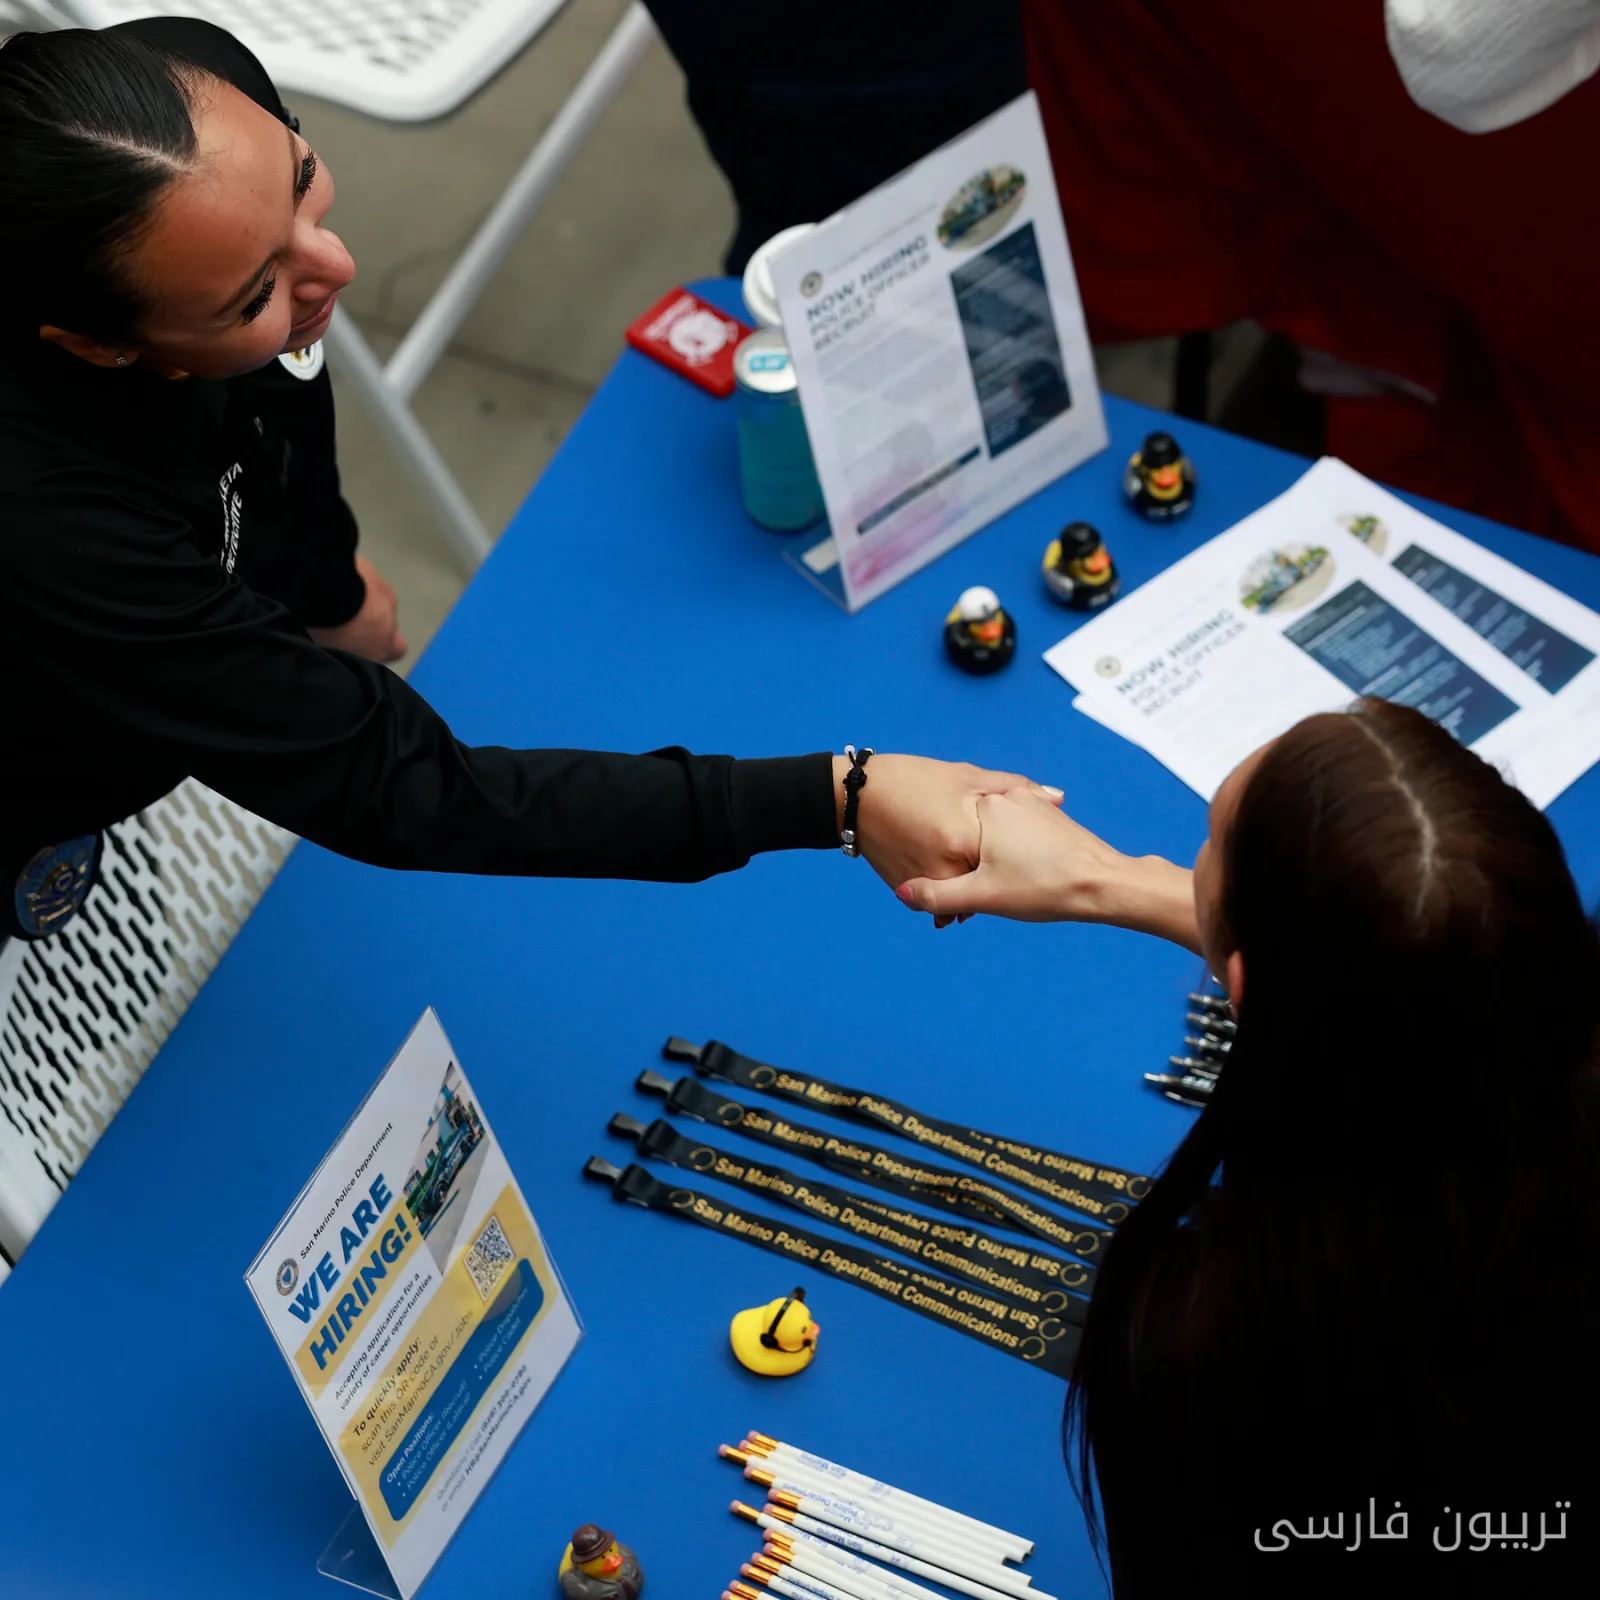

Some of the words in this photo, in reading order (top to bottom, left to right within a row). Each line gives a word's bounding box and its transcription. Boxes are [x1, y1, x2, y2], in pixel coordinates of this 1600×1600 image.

[806, 284, 854, 320] NOW
[860, 235, 925, 284] HIRING
[226, 491, 242, 574] DETECTIVE
[1116, 658, 1166, 695] NOW
[1167, 611, 1233, 659] HIRING
[300, 1239, 314, 1260] San
[312, 1207, 336, 1240] Marino
[334, 1177, 356, 1208] Police
[354, 1122, 393, 1179] Department
[743, 1112, 772, 1131] San
[773, 1122, 824, 1148] Marino
[825, 1139, 871, 1162] Police
[873, 1152, 957, 1202] Department
[958, 1178, 1073, 1242] Communications
[775, 1075, 806, 1093] San
[807, 1083, 856, 1105] Marino
[858, 1096, 903, 1124] Police
[903, 1116, 986, 1163] Department
[985, 1153, 1103, 1214] Communications
[1043, 1155, 1095, 1181] Marino
[1097, 1170, 1128, 1189] San
[288, 1252, 340, 1324] WE
[340, 1174, 392, 1263] ARE
[693, 1199, 723, 1223] San
[723, 1213, 773, 1240] Marino
[774, 1232, 819, 1259] Police
[820, 1249, 903, 1295] Department
[903, 1286, 1019, 1347] Communications
[715, 1158, 744, 1178] San
[744, 1168, 794, 1195] Marino
[794, 1187, 839, 1217] Police
[840, 1208, 923, 1253] Department
[923, 1243, 1041, 1302] Communications
[978, 1239, 1029, 1267] Marino
[1031, 1256, 1061, 1276] San
[310, 1214, 411, 1369] HIRING!
[957, 1290, 1008, 1319] Marino
[1009, 1309, 1040, 1329] San
[335, 1351, 368, 1399] Accepting
[366, 1295, 405, 1353] applications
[402, 1280, 414, 1296] for
[340, 1376, 363, 1411] variety
[362, 1364, 371, 1379] of
[370, 1335, 391, 1367] career
[390, 1274, 432, 1336] opportunities
[353, 1420, 367, 1437] To
[365, 1374, 396, 1422] quickly
[395, 1336, 422, 1377] apply:
[361, 1422, 381, 1451] scan
[380, 1402, 397, 1424] this
[396, 1378, 410, 1401] QR
[409, 1349, 430, 1382] code
[429, 1334, 440, 1351] or
[368, 1440, 385, 1466] visit
[386, 1456, 406, 1484] Open
[403, 1414, 433, 1458] Positions:
